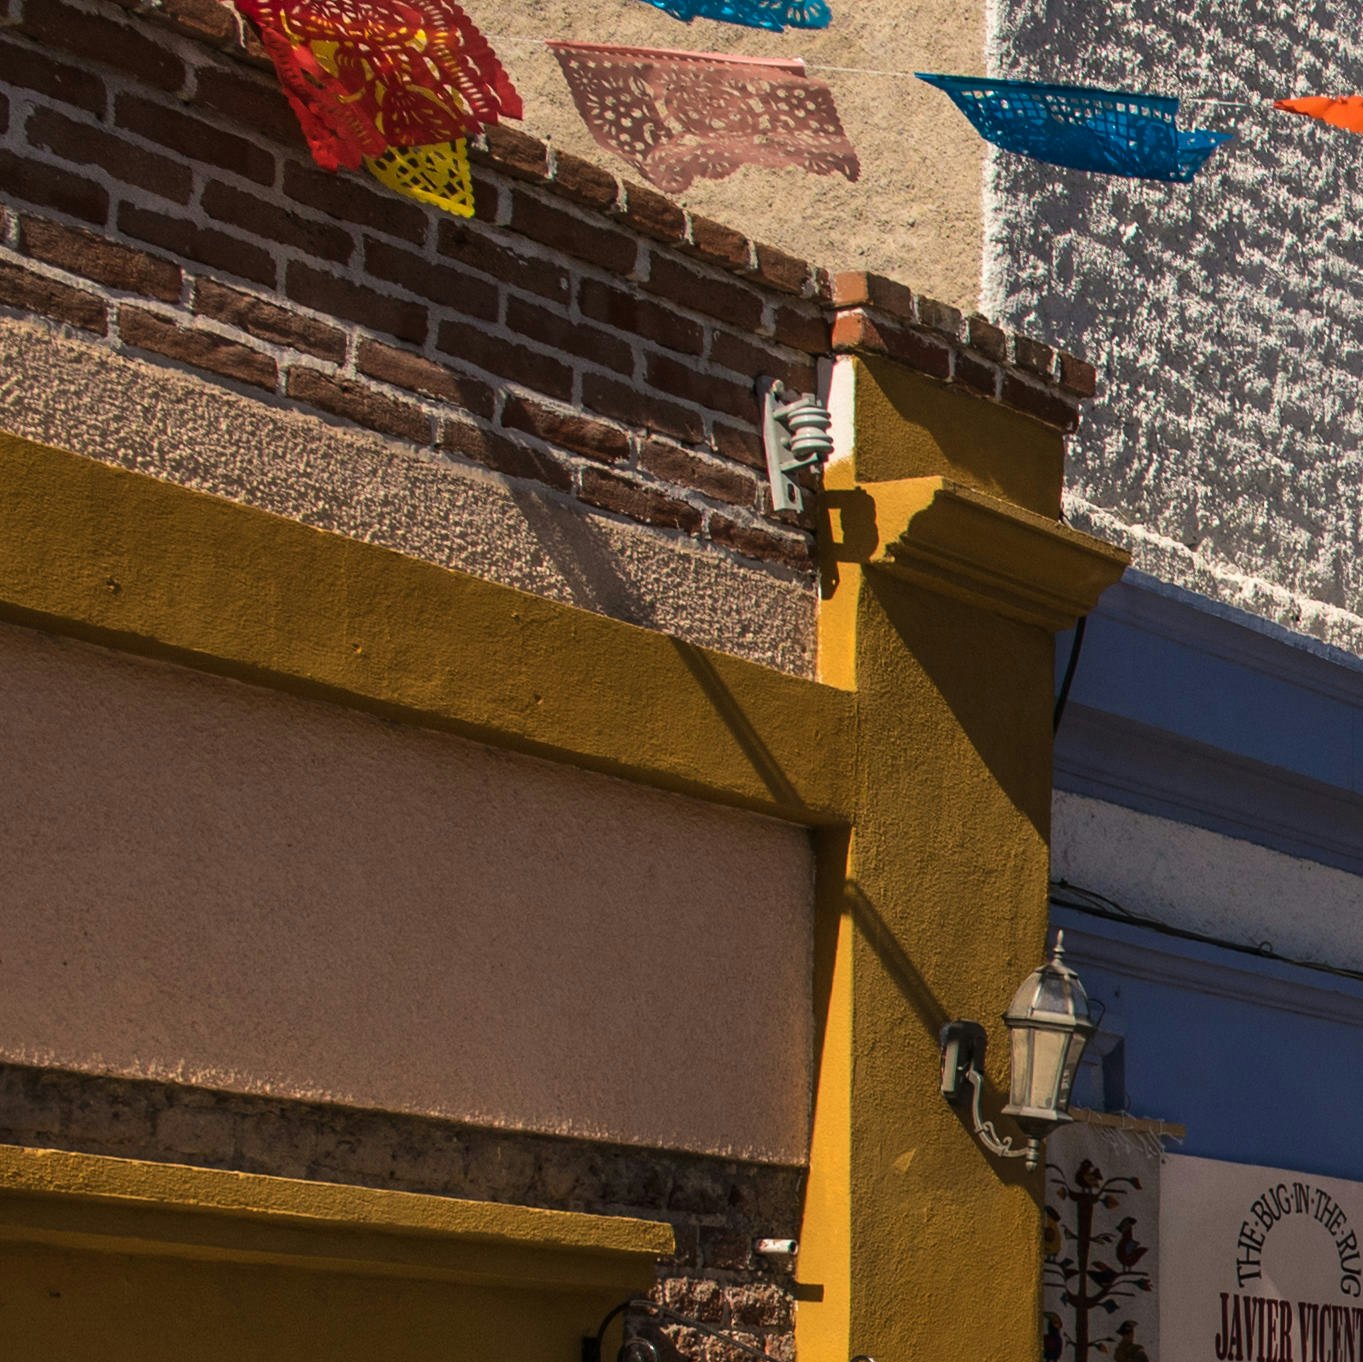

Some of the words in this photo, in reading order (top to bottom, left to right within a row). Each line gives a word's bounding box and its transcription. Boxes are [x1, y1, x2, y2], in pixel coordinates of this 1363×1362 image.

[1250, 1183, 1292, 1233] BUG
[1293, 1182, 1310, 1214] IN
[1314, 1188, 1347, 1236] THE
[1236, 1221, 1266, 1288] THE
[1336, 1230, 1361, 1298] RUG
